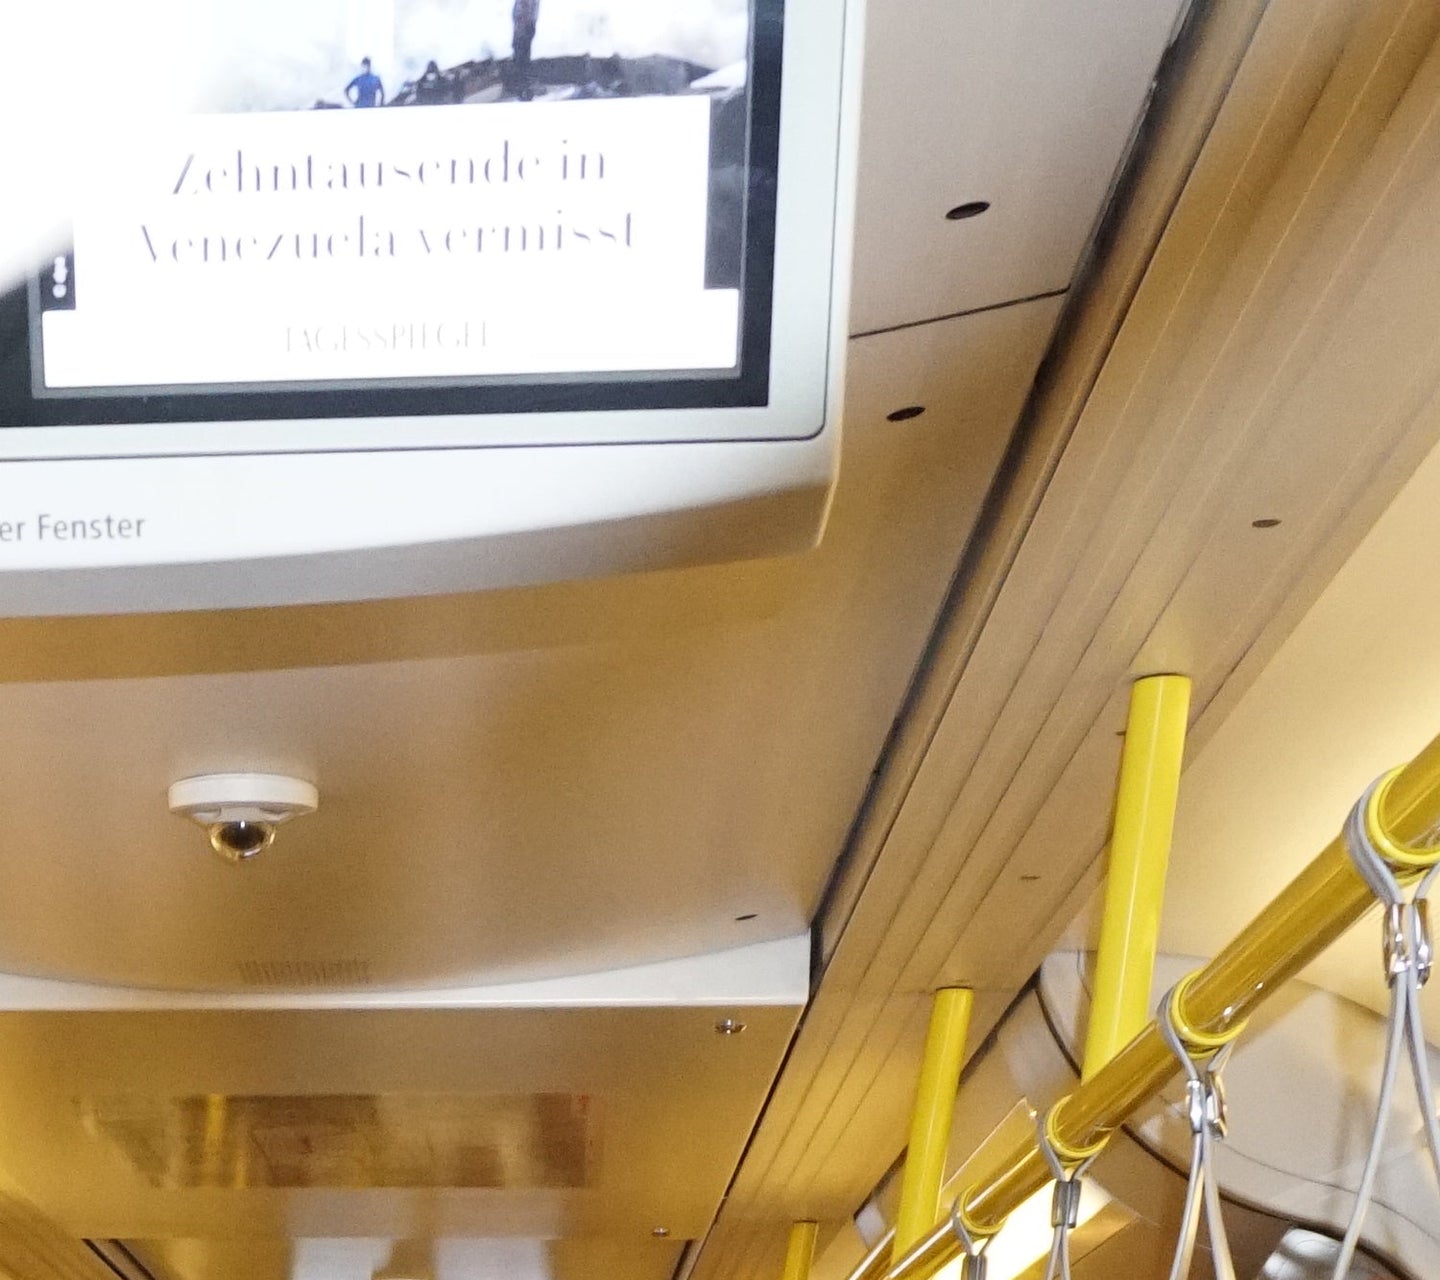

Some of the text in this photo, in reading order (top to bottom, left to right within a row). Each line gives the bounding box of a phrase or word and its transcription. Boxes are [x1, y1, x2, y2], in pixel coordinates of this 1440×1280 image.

[173, 139, 607, 196] Zehntausende in
[140, 209, 634, 264] Venezuela vermisst
[38, 512, 147, 540] Fenster
